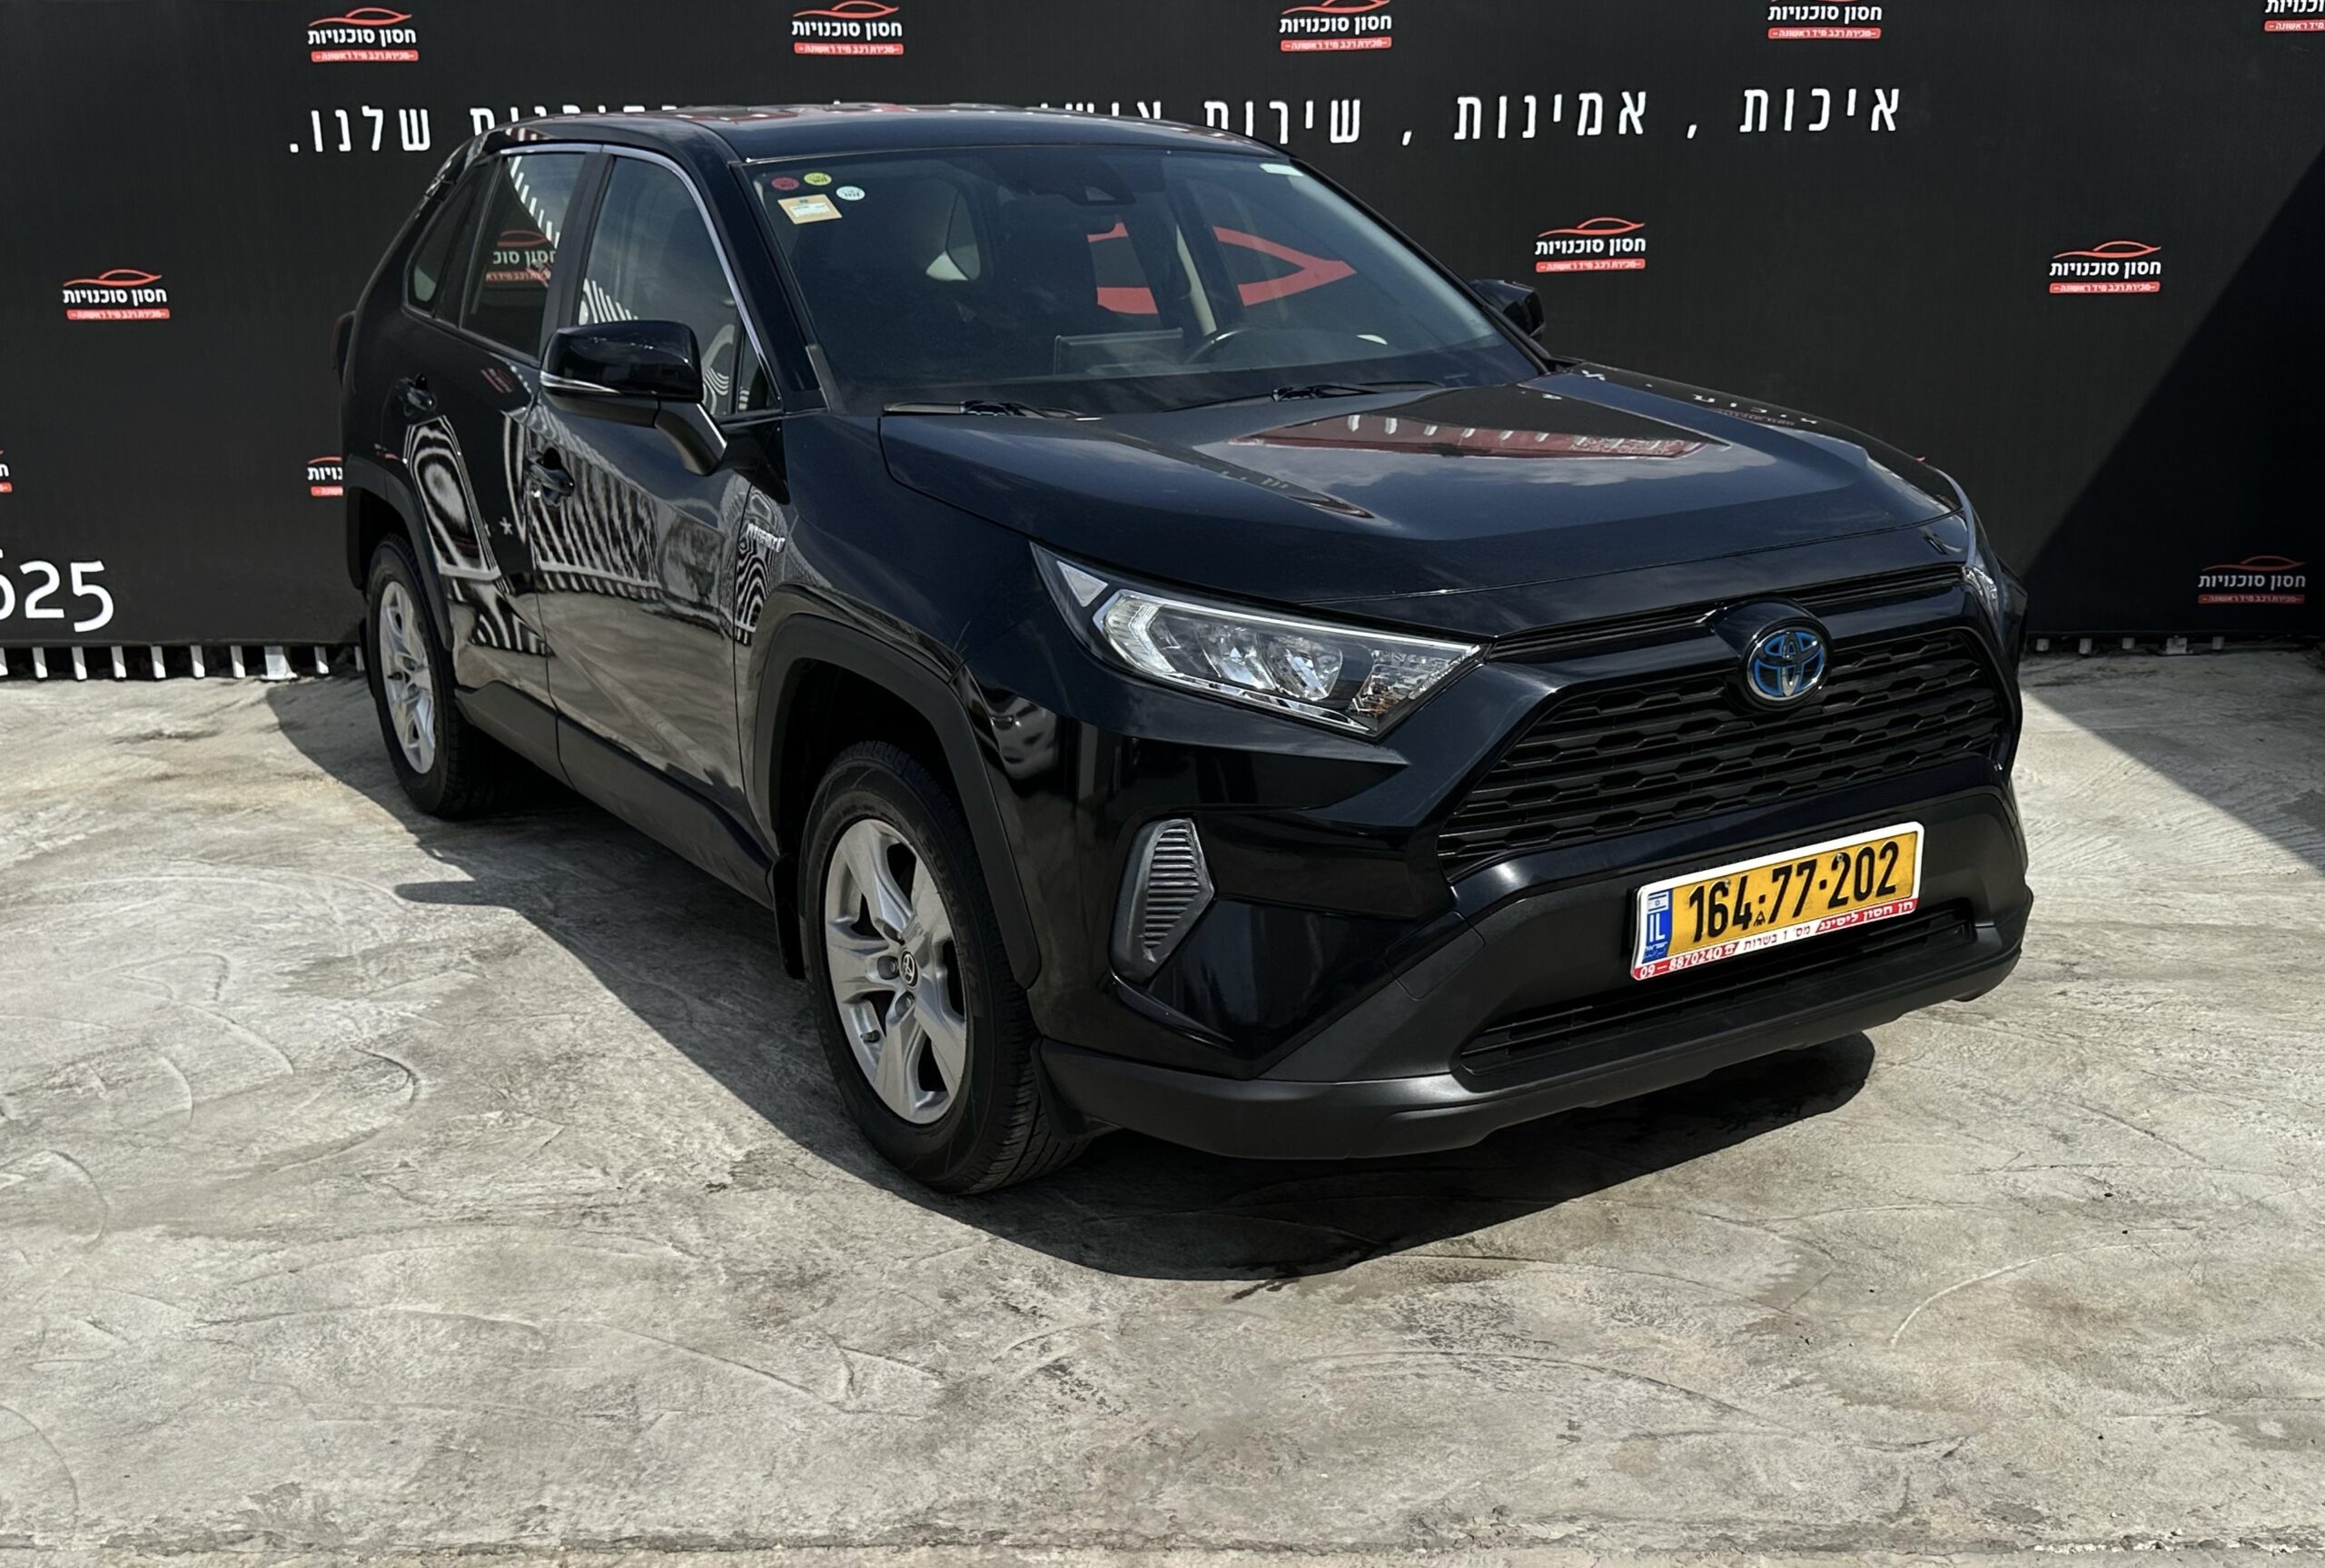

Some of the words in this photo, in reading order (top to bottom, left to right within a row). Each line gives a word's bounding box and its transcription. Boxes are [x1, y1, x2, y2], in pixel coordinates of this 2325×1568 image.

[1767, 6, 1839, 20] סוכנויות
[2265, 0, 2325, 13] וכנויות
[1845, 6, 1882, 24] חסון
[792, 21, 860, 36] סוכנויות
[866, 22, 903, 41] חסון
[1280, 17, 1350, 33] סוכנויות
[1354, 15, 1391, 35] חסון
[308, 29, 375, 44] סוכנויות
[380, 29, 416, 47] חסון
[1453, 92, 1647, 140] אמינות
[1739, 88, 1900, 133] איכות
[1535, 239, 1604, 255] סוכנויות
[1609, 238, 1646, 256] חסון
[2049, 262, 2119, 276] סוכנויות
[2124, 261, 2162, 279] חסון
[63, 290, 127, 303] סוכנויות
[132, 289, 167, 307] חסון
[308, 467, 342, 480] נויות
[2198, 575, 2265, 587] סוכנויות
[2271, 575, 2306, 591] חסון
[1863, 905, 1893, 922] חסון
[1897, 901, 1914, 913] חן
[1649, 912, 1666, 942] IL
[1743, 932, 1777, 951] בשרות
